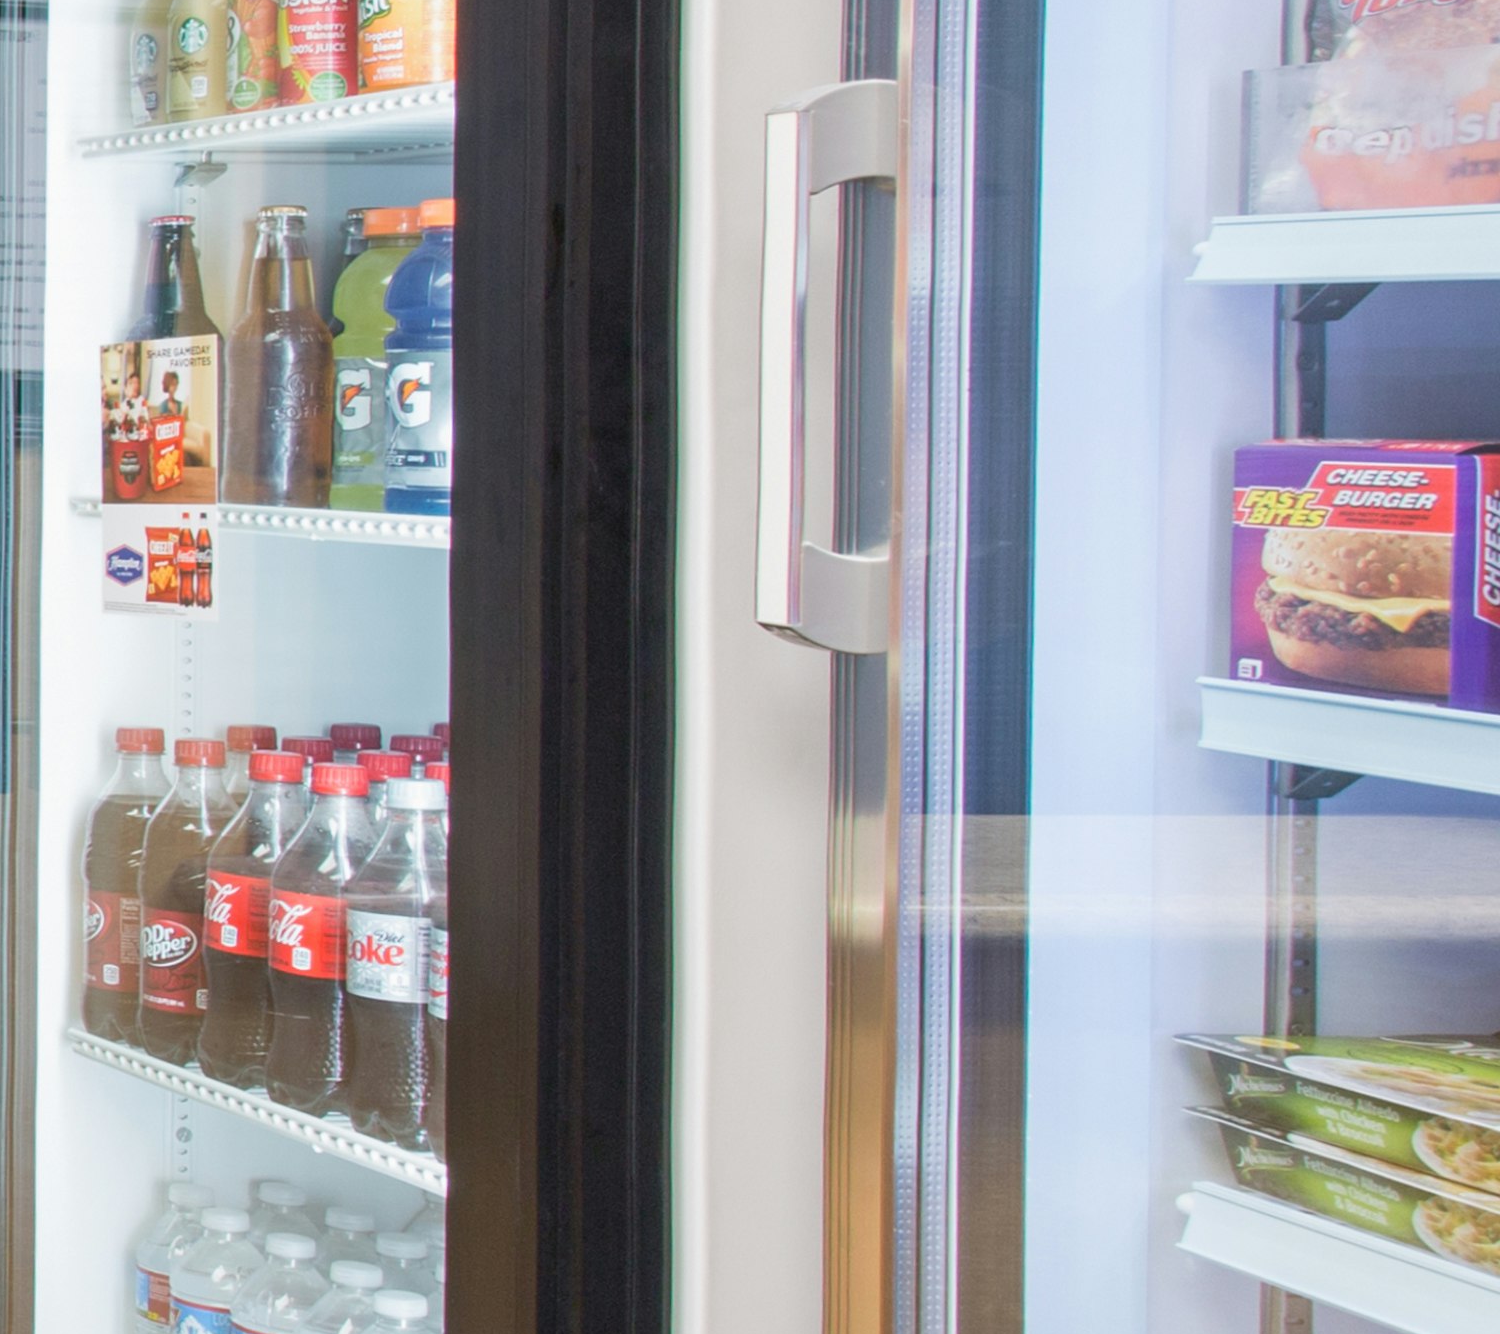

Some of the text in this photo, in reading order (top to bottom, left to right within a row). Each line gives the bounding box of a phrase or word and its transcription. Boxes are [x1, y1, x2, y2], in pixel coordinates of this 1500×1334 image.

[289, 21, 346, 33] Strawberry
[305, 30, 346, 40] Banana
[364, 28, 403, 42] Tropical
[314, 42, 347, 53] JUICE
[372, 41, 403, 53] Blend
[146, 345, 211, 360] SHARE GAMEDAY
[169, 357, 212, 368] FAVORITES
[336, 368, 373, 431] G
[388, 361, 434, 429] G
[1326, 468, 1431, 488] CHEESE-
[1244, 490, 1319, 509] FAST
[1332, 490, 1439, 510] BURGER
[1247, 508, 1330, 528] BITES
[152, 924, 171, 942] Dr
